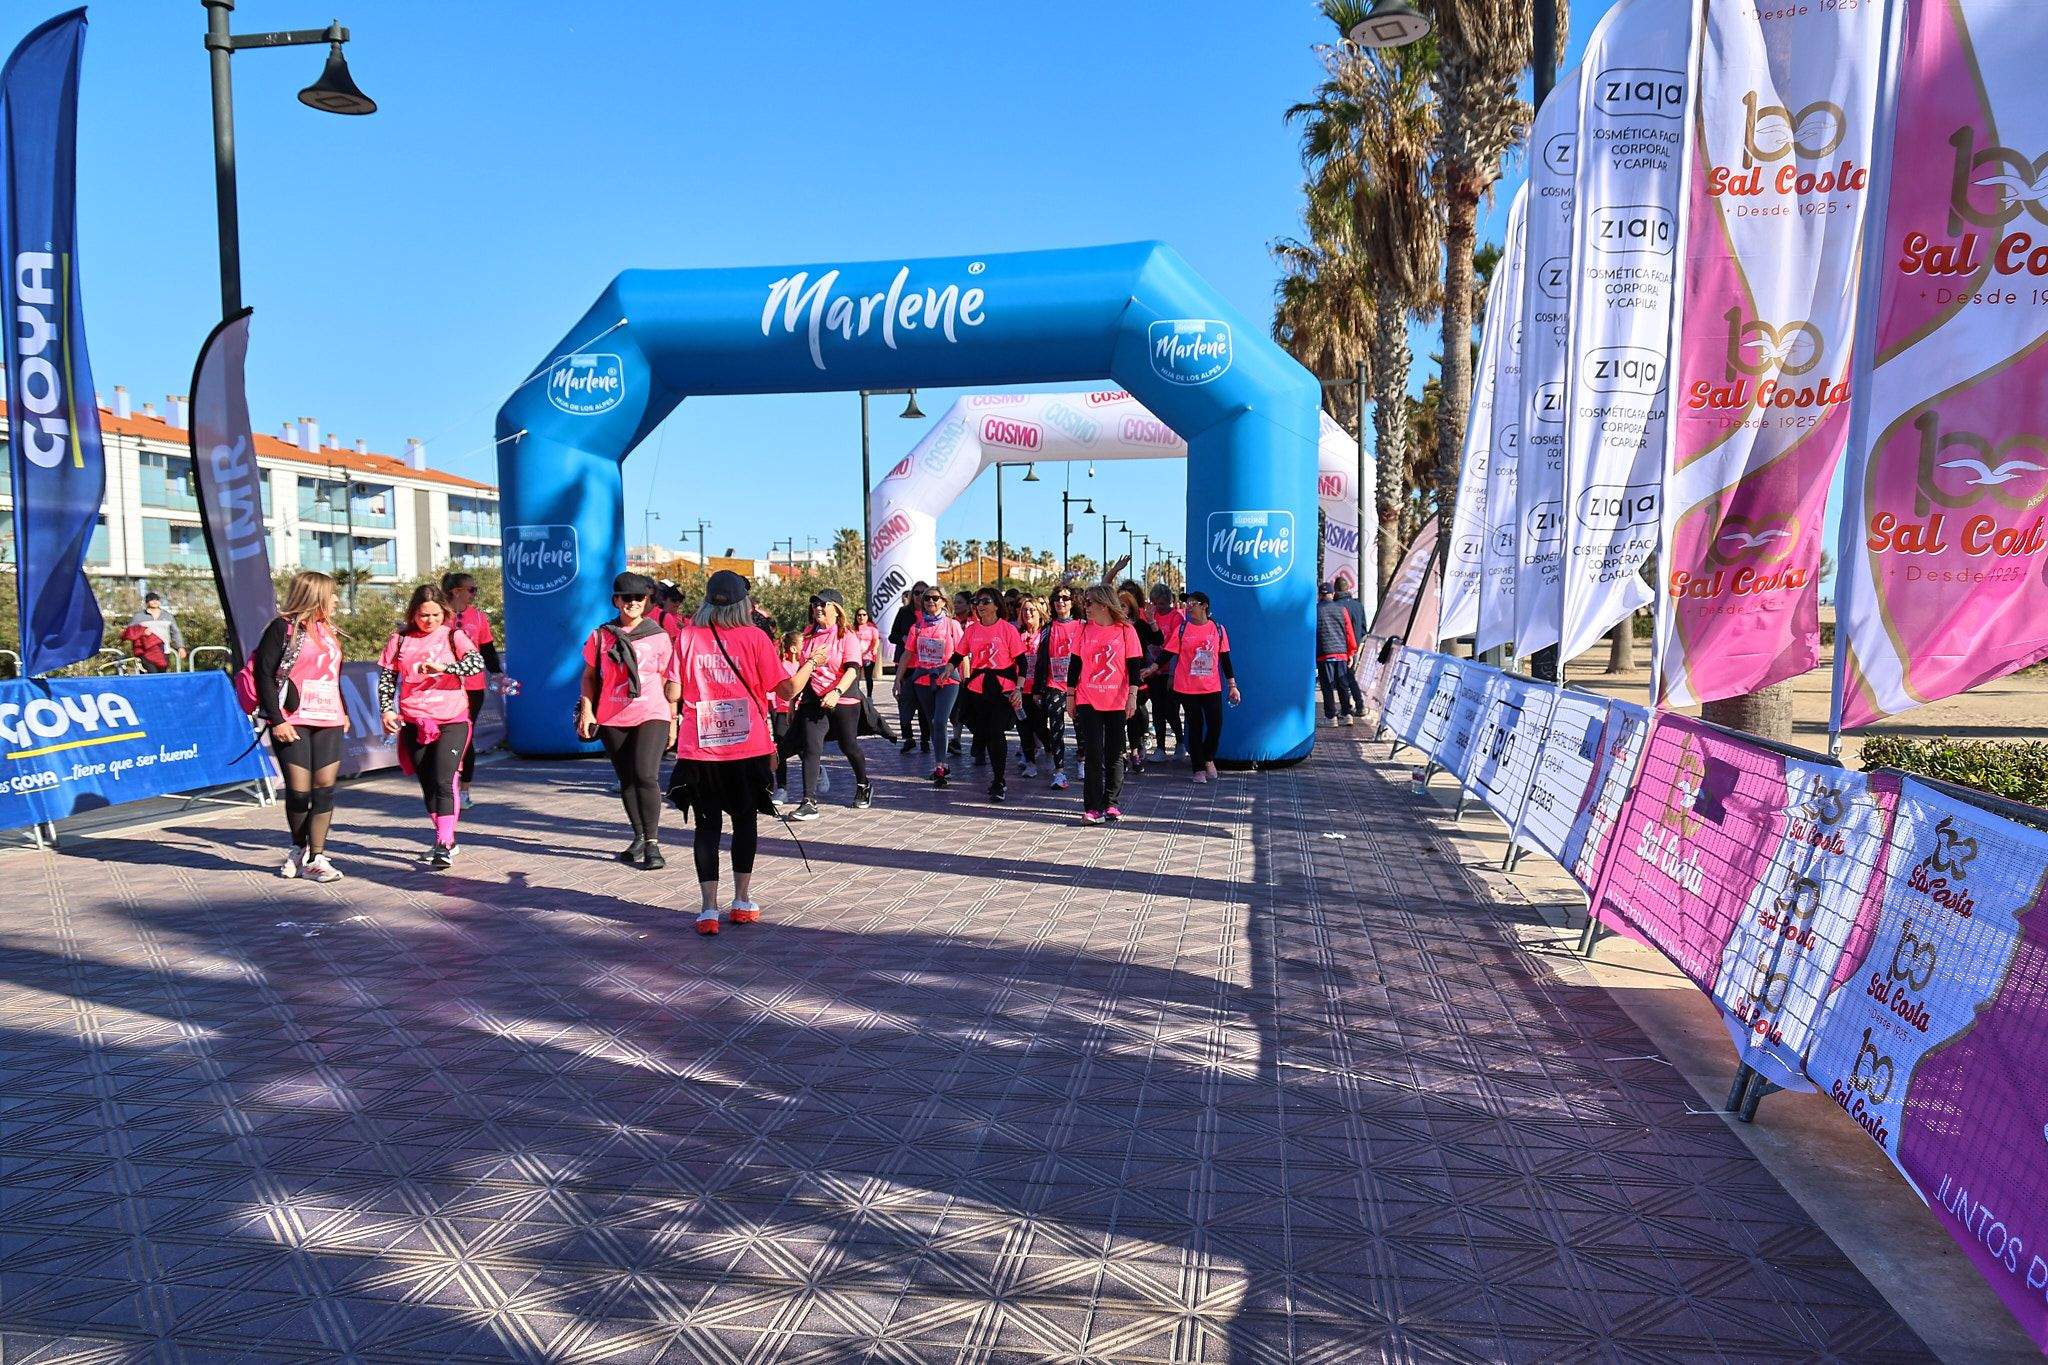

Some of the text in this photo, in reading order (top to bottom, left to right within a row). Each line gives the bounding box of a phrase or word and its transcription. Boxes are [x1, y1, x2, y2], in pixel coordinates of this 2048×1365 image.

[1752, 6, 1808, 21] Desde
[1611, 143, 1671, 158] CORPORAL
[1613, 158, 1668, 173] Y CAPILAR
[1707, 160, 1867, 197] Sal Costa
[1737, 202, 1838, 217] Desde 1925
[1899, 231, 1982, 278] Sal
[1605, 283, 1659, 297] CORPORA
[1607, 298, 1615, 309] Y
[1937, 288, 2017, 305] Desde
[761, 265, 985, 370] Marlene
[15, 251, 70, 469] GOYA
[1156, 333, 1226, 368] Marlene
[552, 367, 618, 399] Marlene
[1688, 377, 1852, 411] Sal Costa
[984, 418, 1039, 449] COSMO
[1720, 415, 1817, 429] Desde 1925
[211, 435, 260, 562] IMR
[1212, 527, 1289, 566] Marlene
[1866, 511, 1949, 556] Sal
[507, 540, 572, 576] Marlene
[1215, 564, 1230, 578] HIJA
[1231, 573, 1242, 582] DE
[1260, 565, 1283, 581] ALPES
[1906, 565, 1985, 583] Desde
[1669, 562, 1810, 600] Sal Costa
[0, 692, 140, 749] GOYA
[11, 771, 58, 791] GOYA
[109, 760, 134, 781] que
[136, 754, 158, 768] ser
[160, 743, 199, 764] bueno!
[1789, 817, 1809, 841] Sal
[1758, 906, 1780, 932] Sal
[1866, 972, 1931, 1033] Sal Costa
[1829, 1078, 1889, 1149] Sal Costa
[1932, 1173, 2023, 1274] JUNTOS
